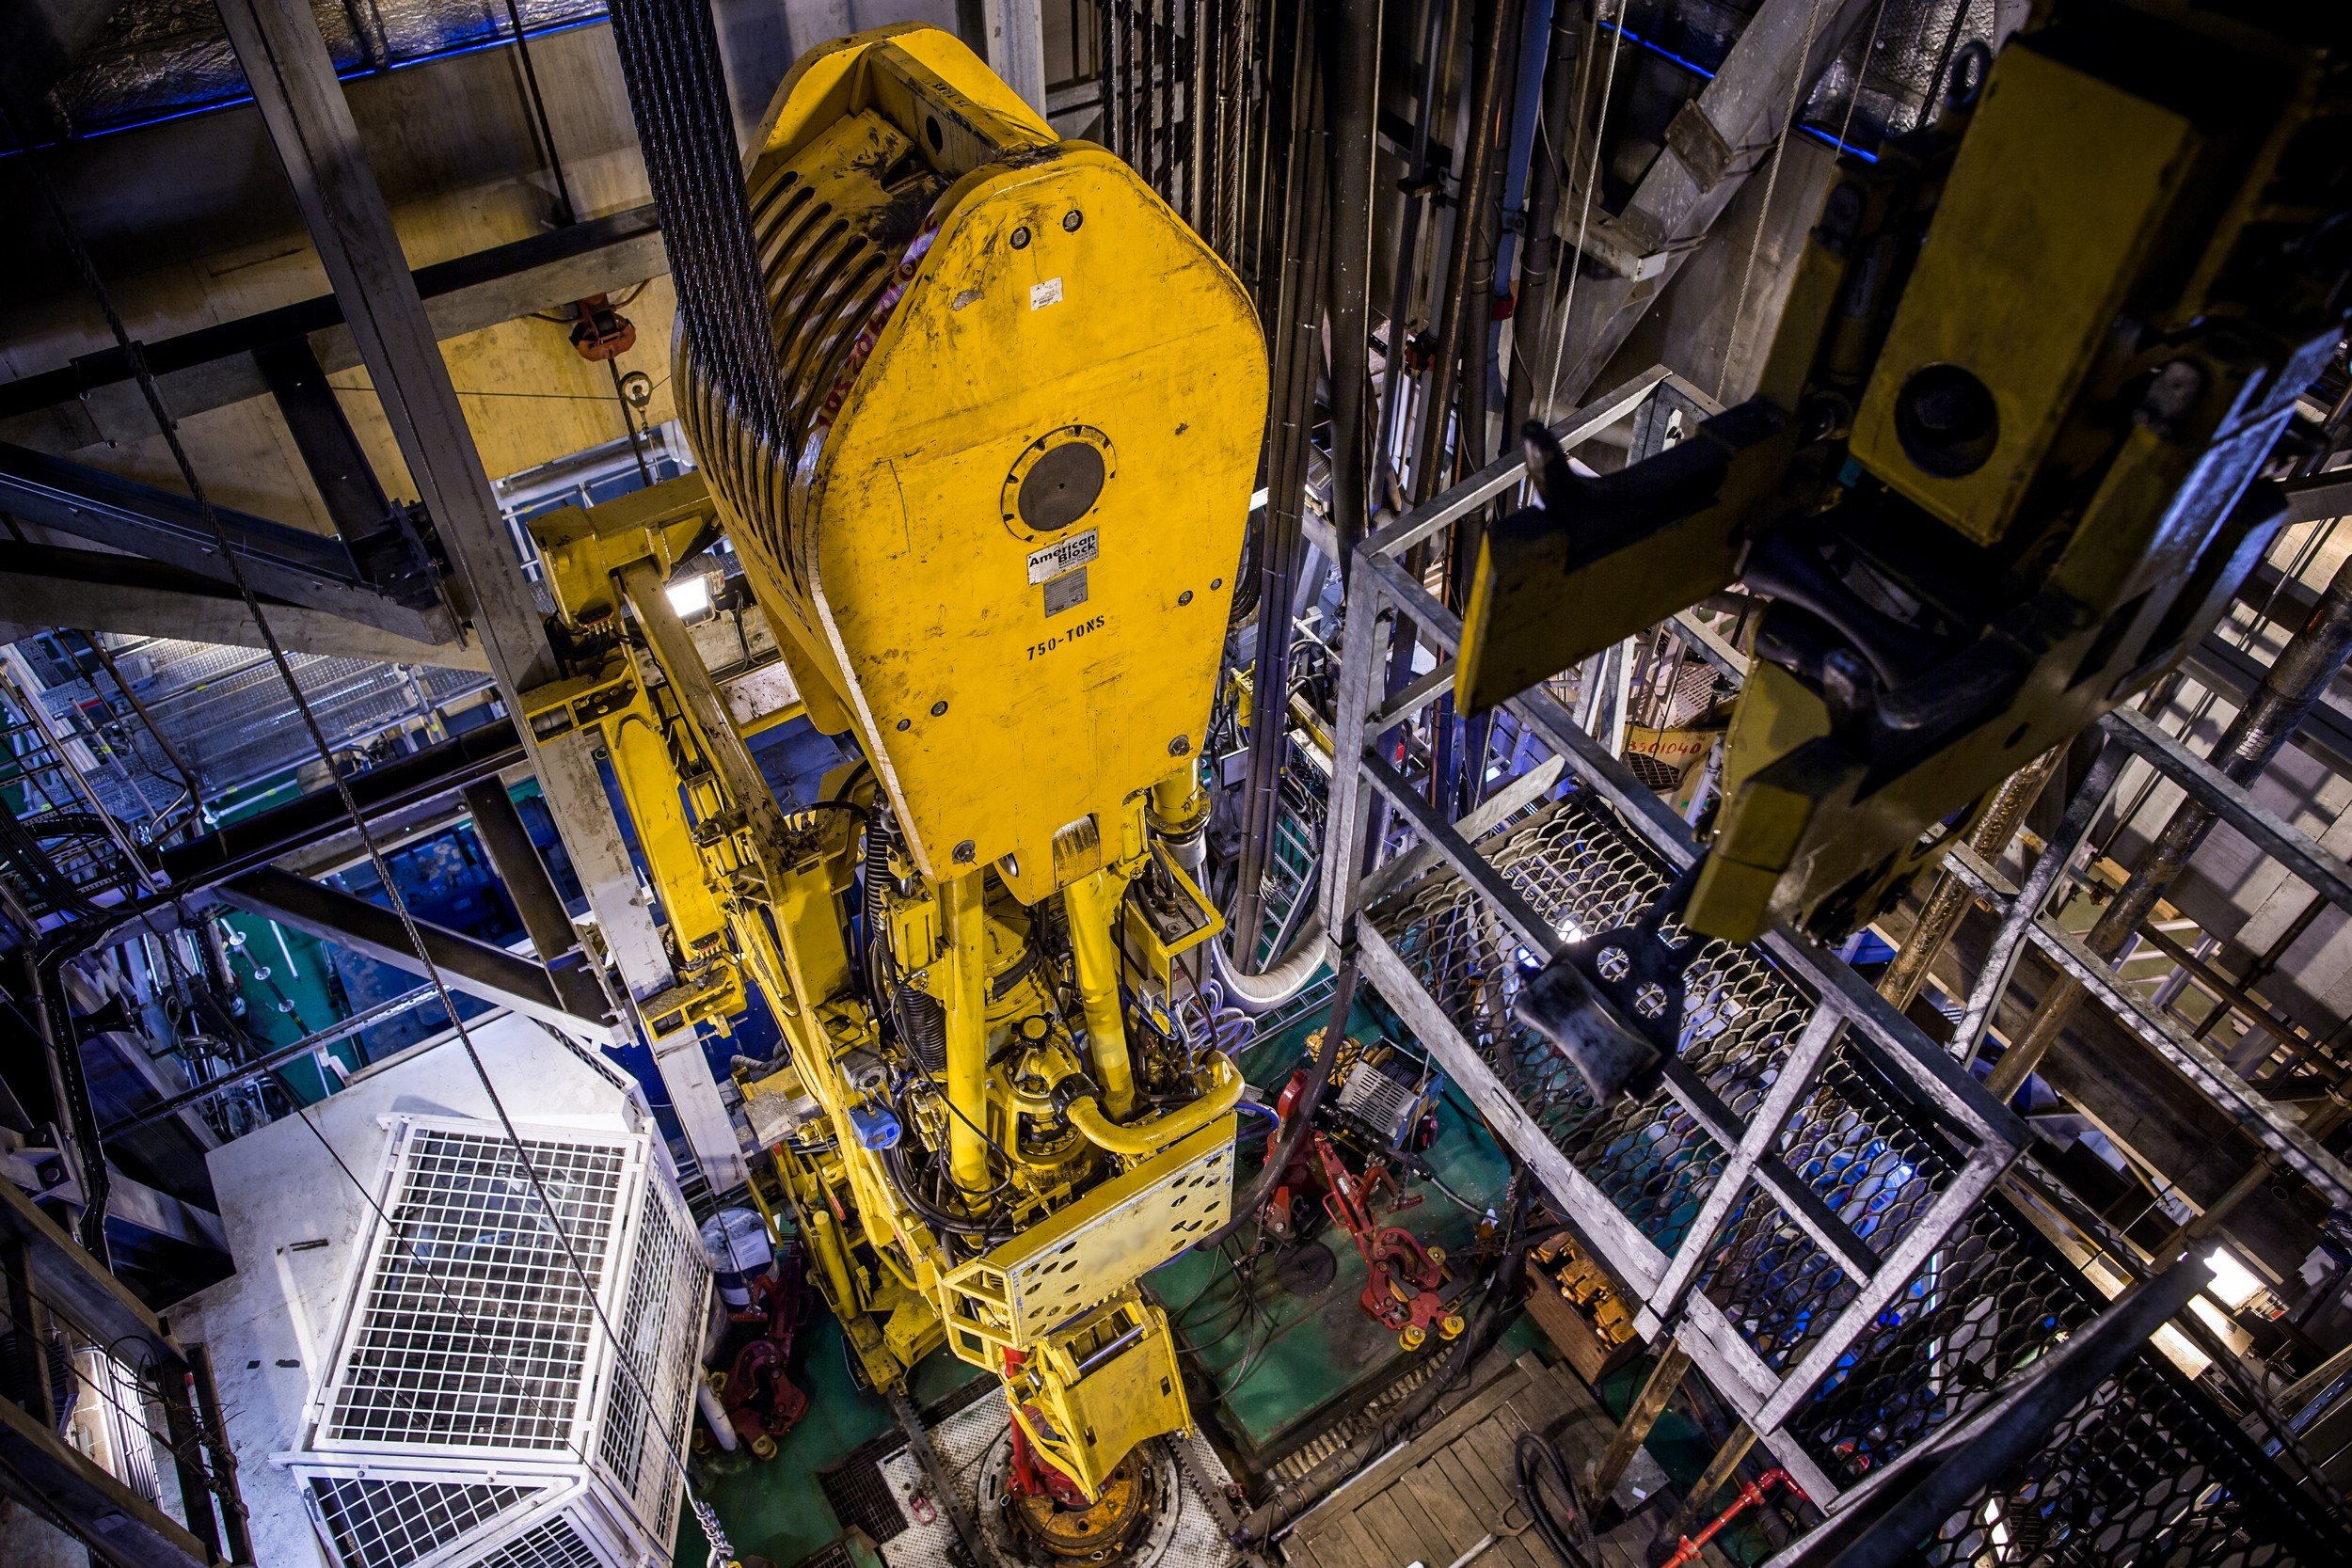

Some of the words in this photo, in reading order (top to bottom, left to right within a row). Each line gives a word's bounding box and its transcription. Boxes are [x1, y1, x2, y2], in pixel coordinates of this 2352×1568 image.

[1029, 534, 1095, 568] American
[1057, 542, 1096, 564] Block
[1026, 614, 1105, 661] 750-TONS
